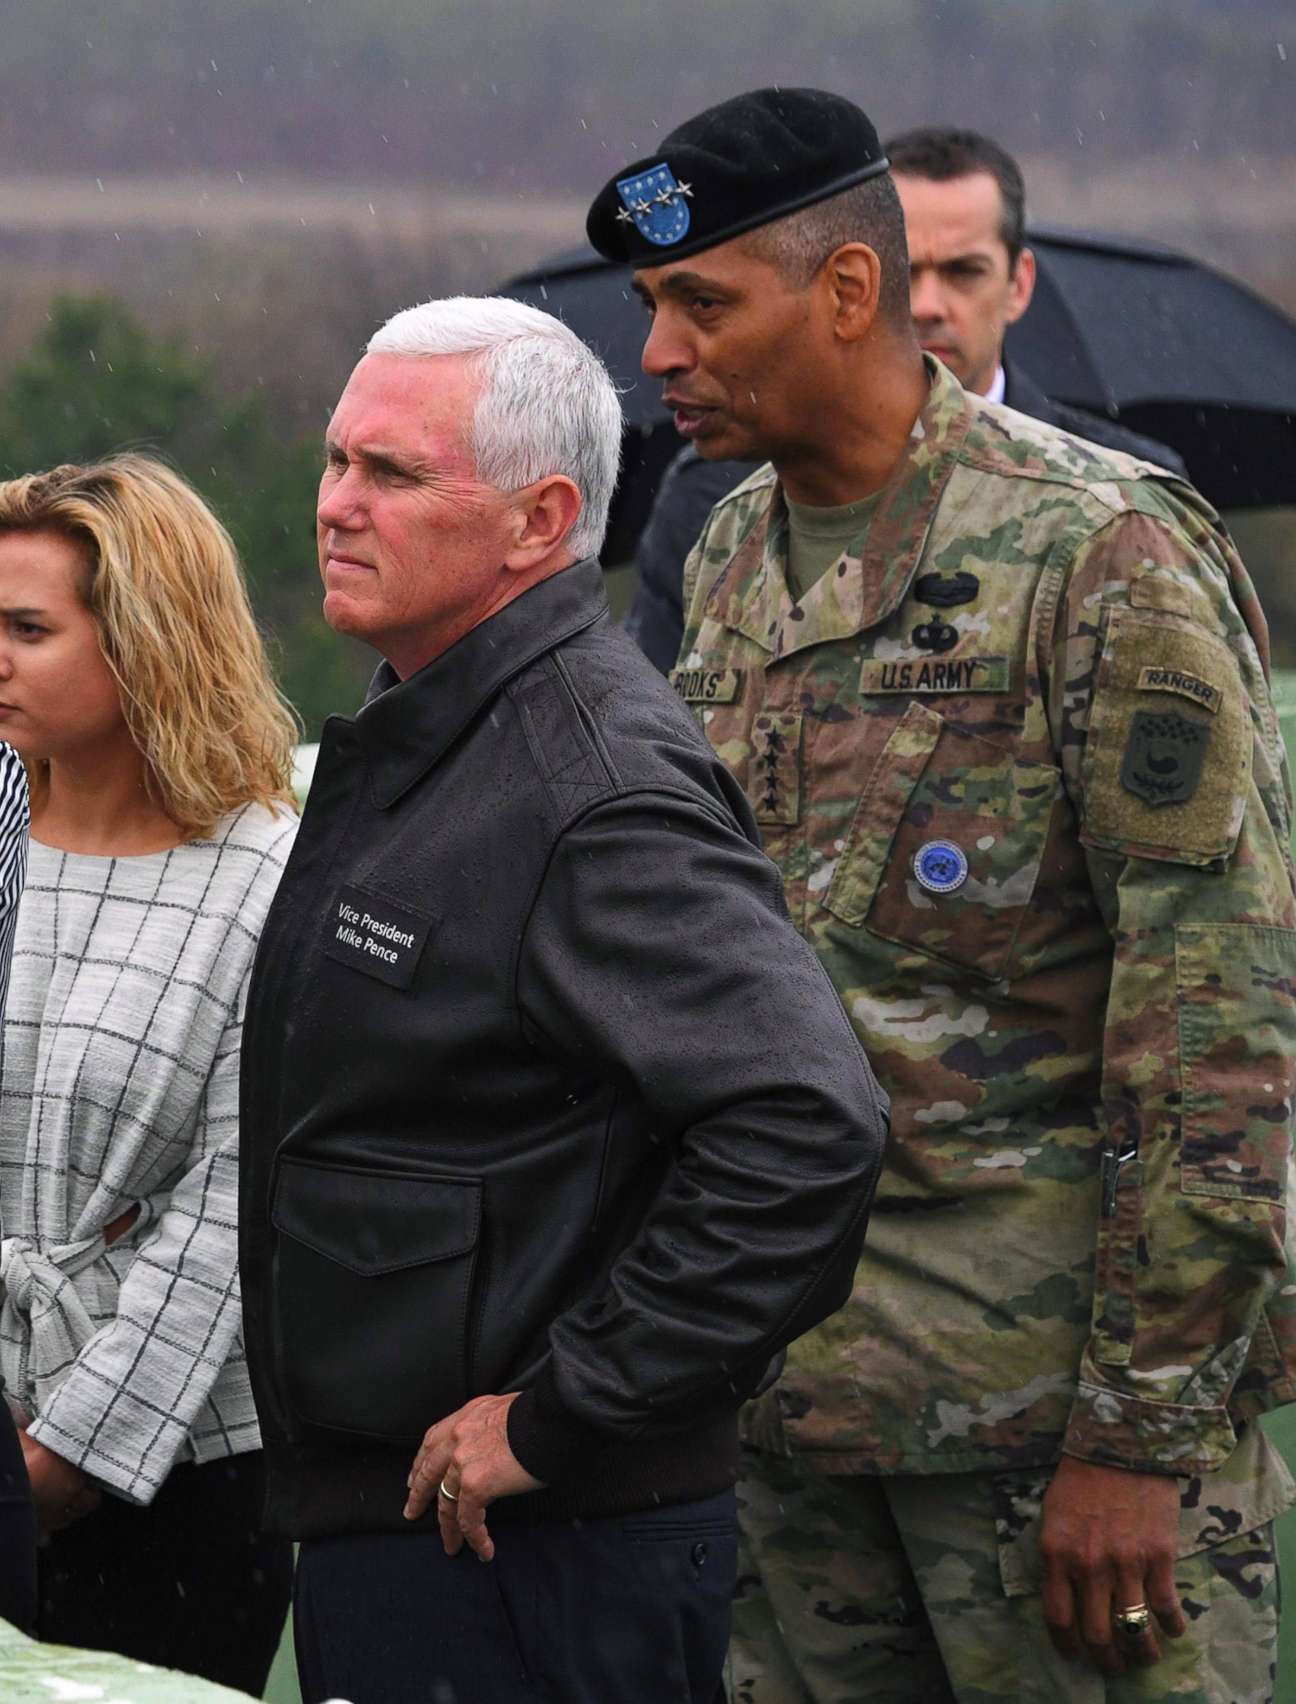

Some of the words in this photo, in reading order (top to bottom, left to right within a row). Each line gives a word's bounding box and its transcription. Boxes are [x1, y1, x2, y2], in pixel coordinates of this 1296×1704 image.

[916, 660, 977, 690] ARMY
[1147, 670, 1213, 700] RANGER
[338, 902, 360, 924] Vice
[360, 913, 415, 949] President
[336, 924, 363, 948] Mike
[363, 937, 399, 964] Pence
